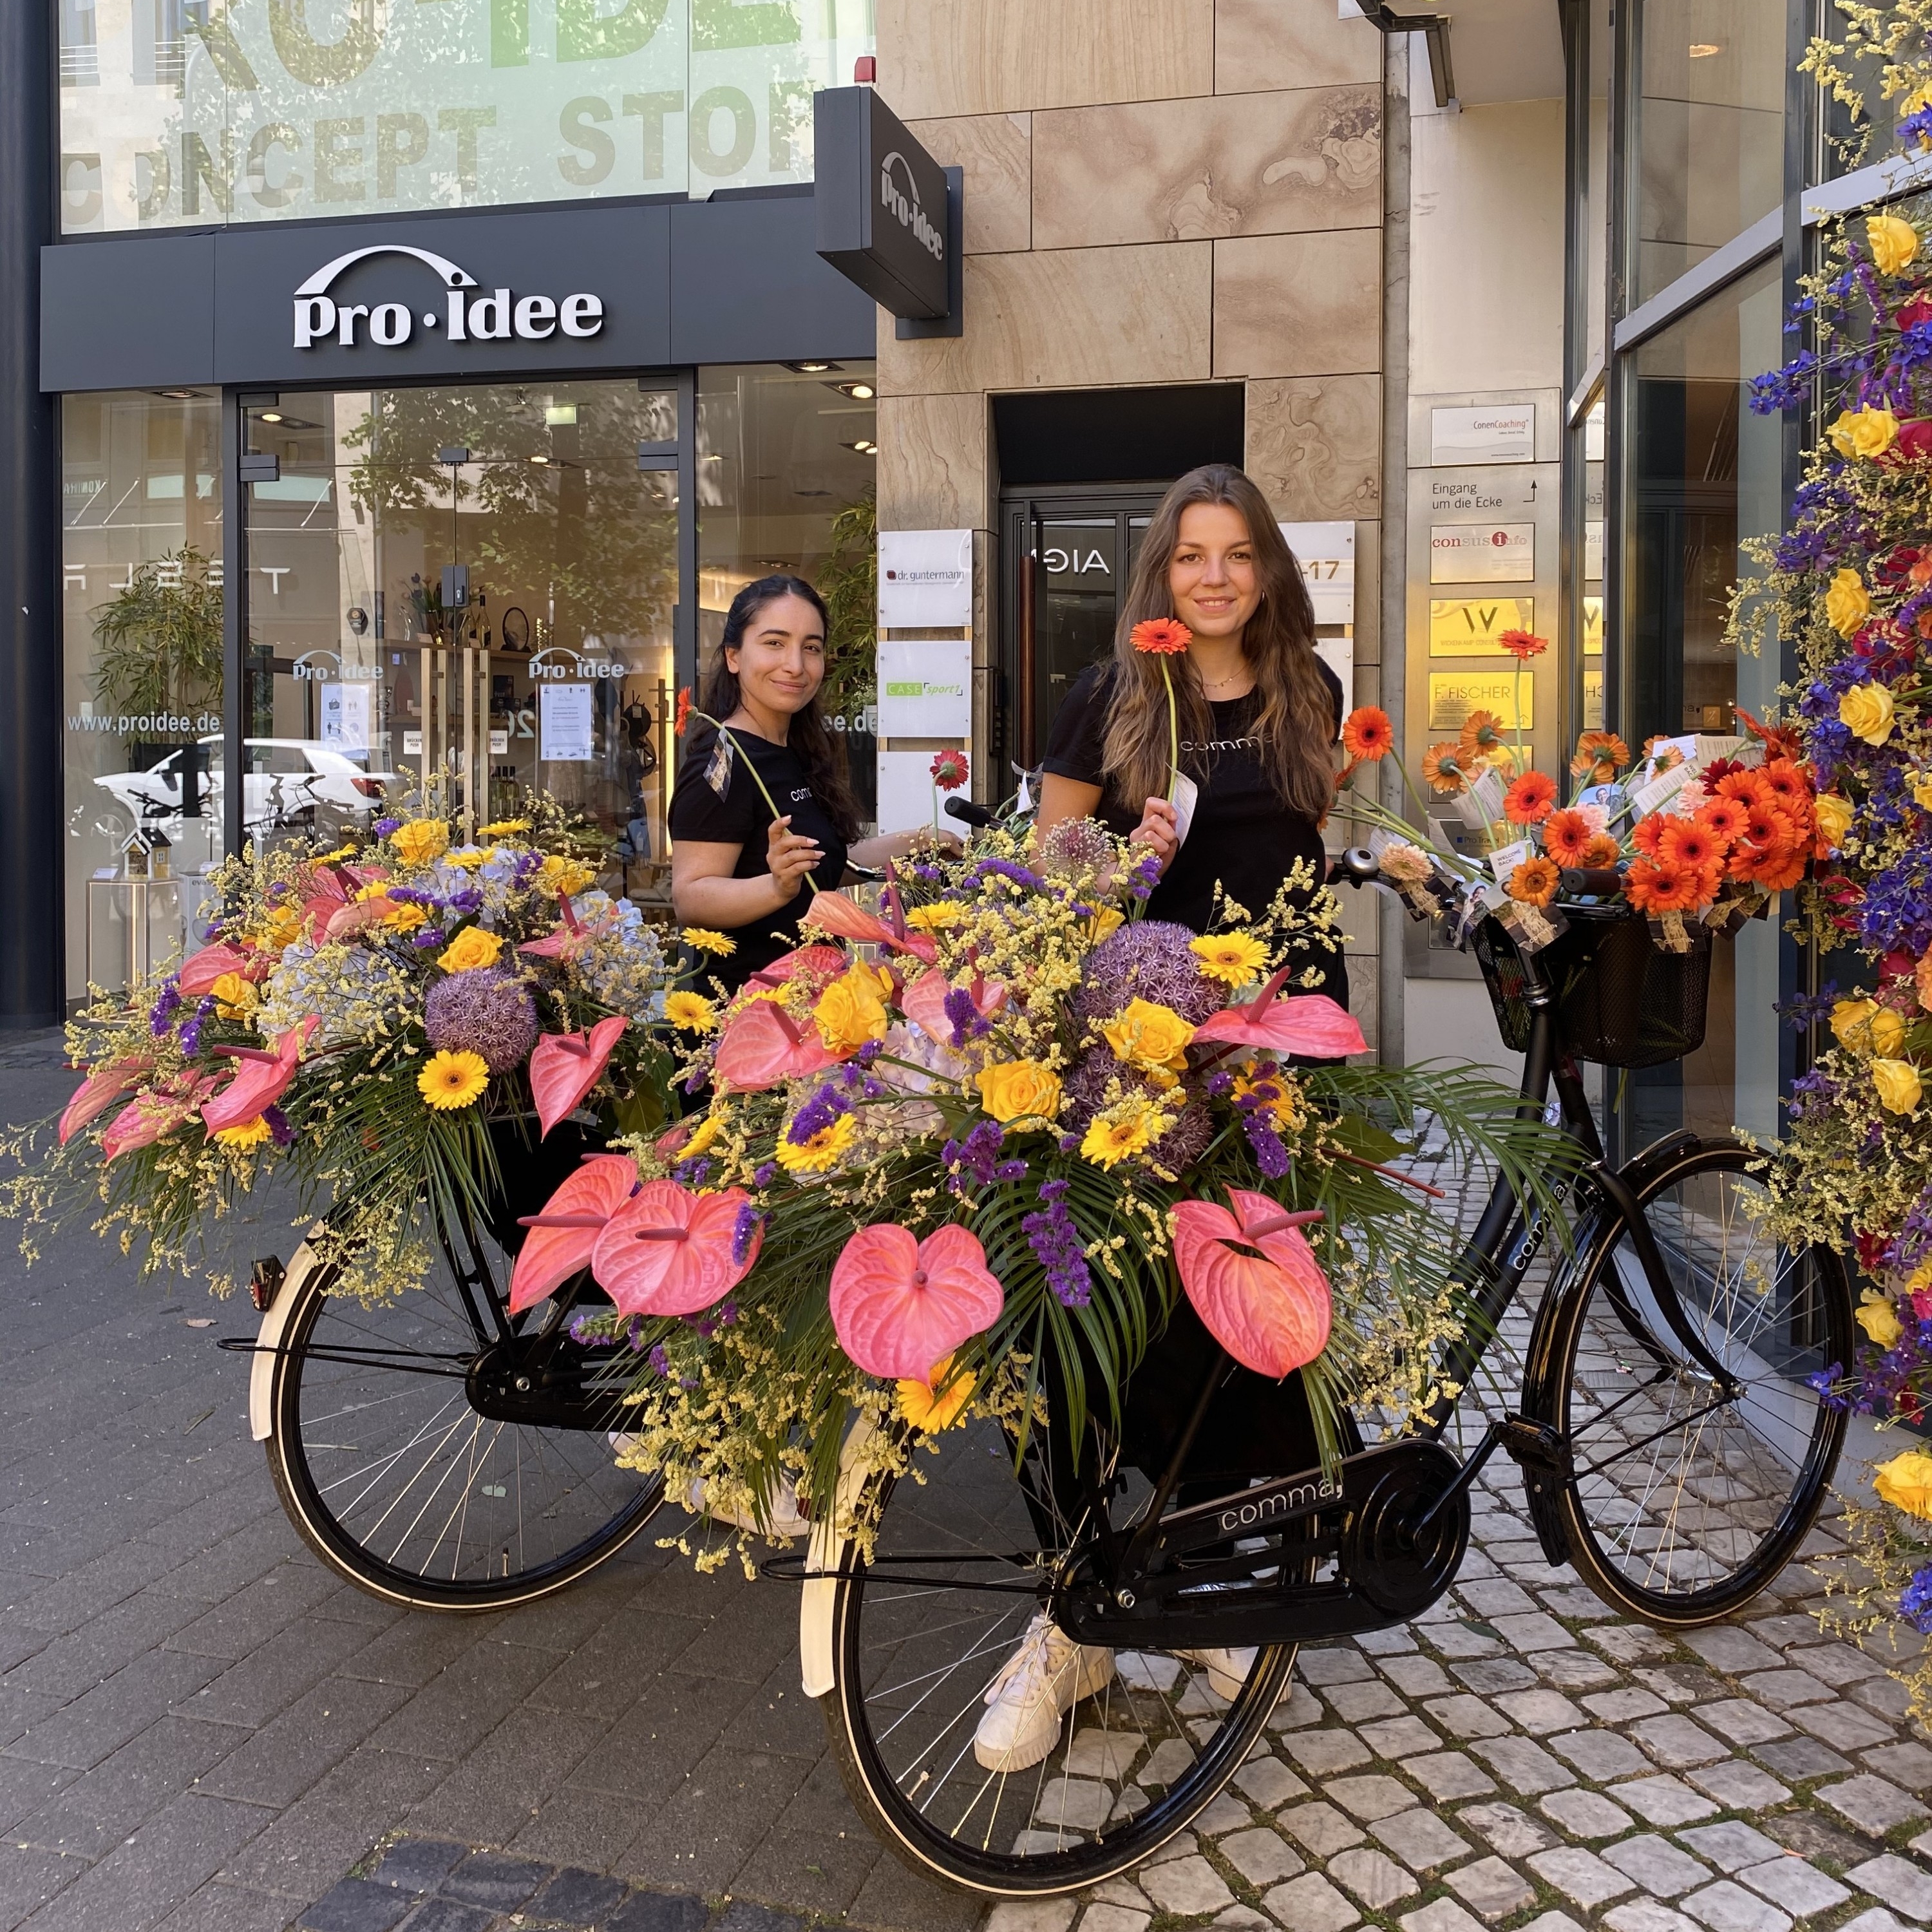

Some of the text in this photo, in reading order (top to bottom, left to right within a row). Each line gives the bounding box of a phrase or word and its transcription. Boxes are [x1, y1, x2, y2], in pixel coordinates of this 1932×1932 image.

[1432, 483, 1477, 495] Eingang
[1455, 498, 1472, 508] die
[1476, 497, 1502, 507] Ecke
[898, 570, 965, 582] dr. guntermann
[888, 685, 920, 694] CASE
[1448, 687, 1511, 699] FISCHER
[68, 711, 220, 735] www.proidee.de
